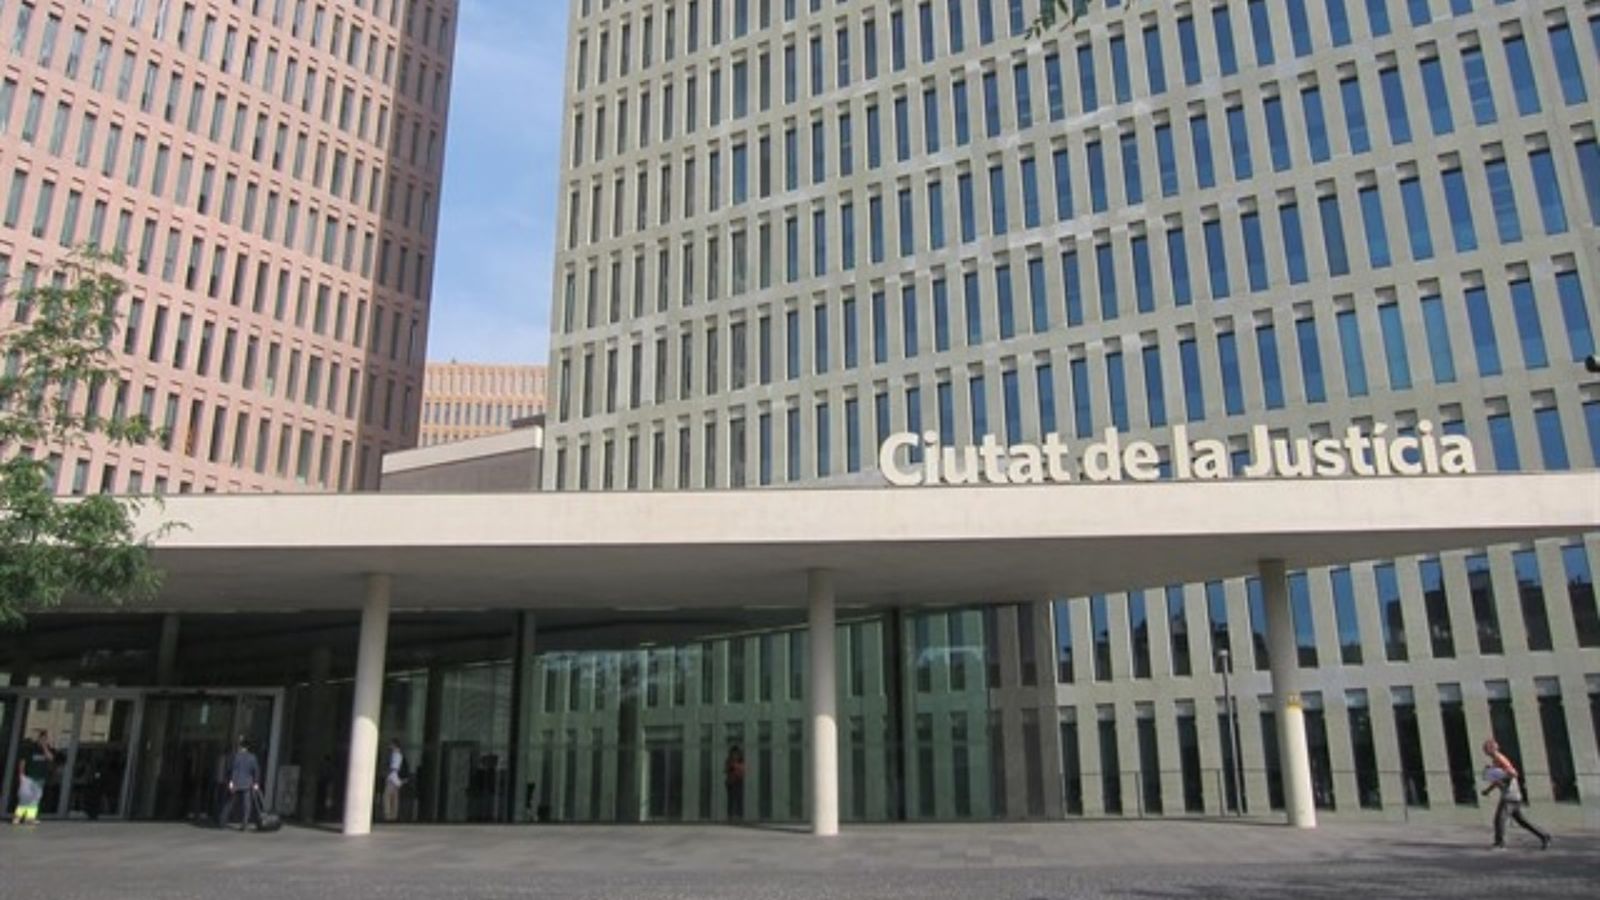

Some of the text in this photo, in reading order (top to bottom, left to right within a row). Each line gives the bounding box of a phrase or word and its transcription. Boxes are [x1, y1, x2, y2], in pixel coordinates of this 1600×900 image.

[879, 419, 1477, 486] Ciutat de la Justícia
